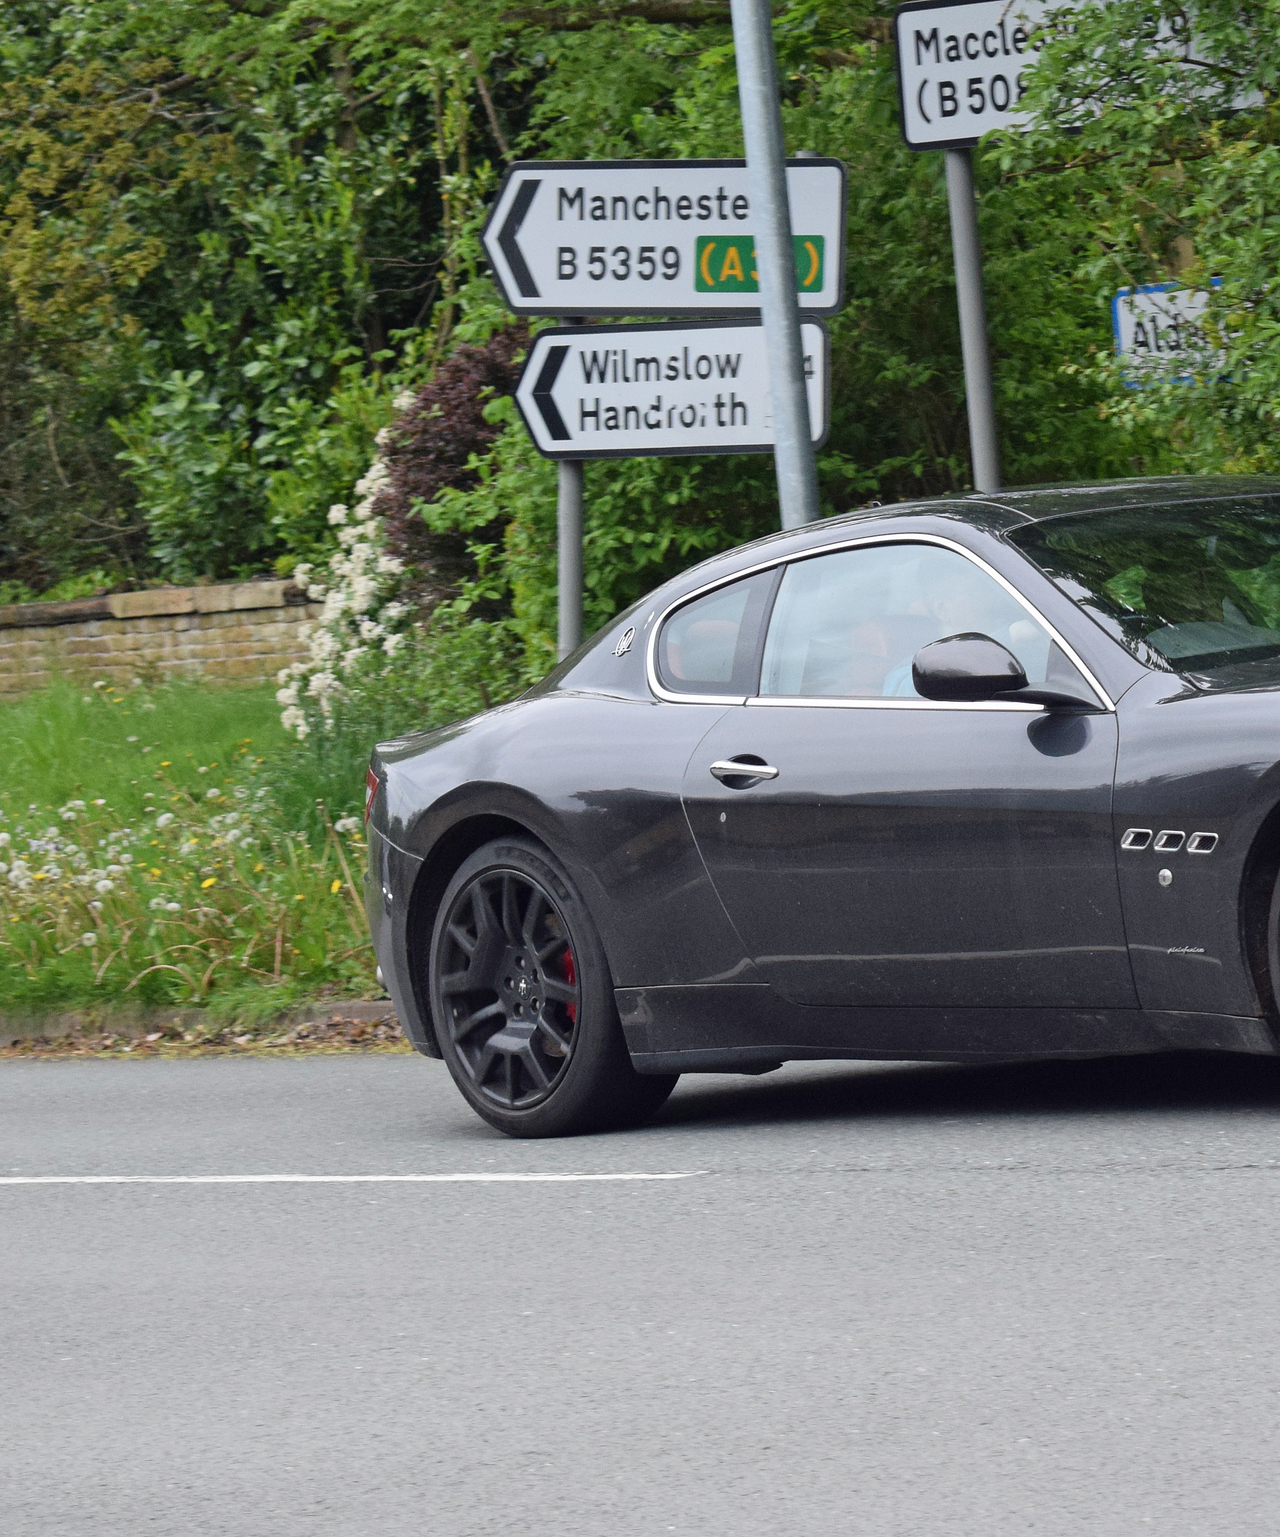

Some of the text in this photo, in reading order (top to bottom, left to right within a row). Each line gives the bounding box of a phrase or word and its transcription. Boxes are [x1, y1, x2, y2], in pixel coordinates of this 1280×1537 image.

[557, 186, 750, 222] Mancheste
[557, 241, 819, 287] B5359 (A)
[580, 346, 742, 384] Wilmslow
